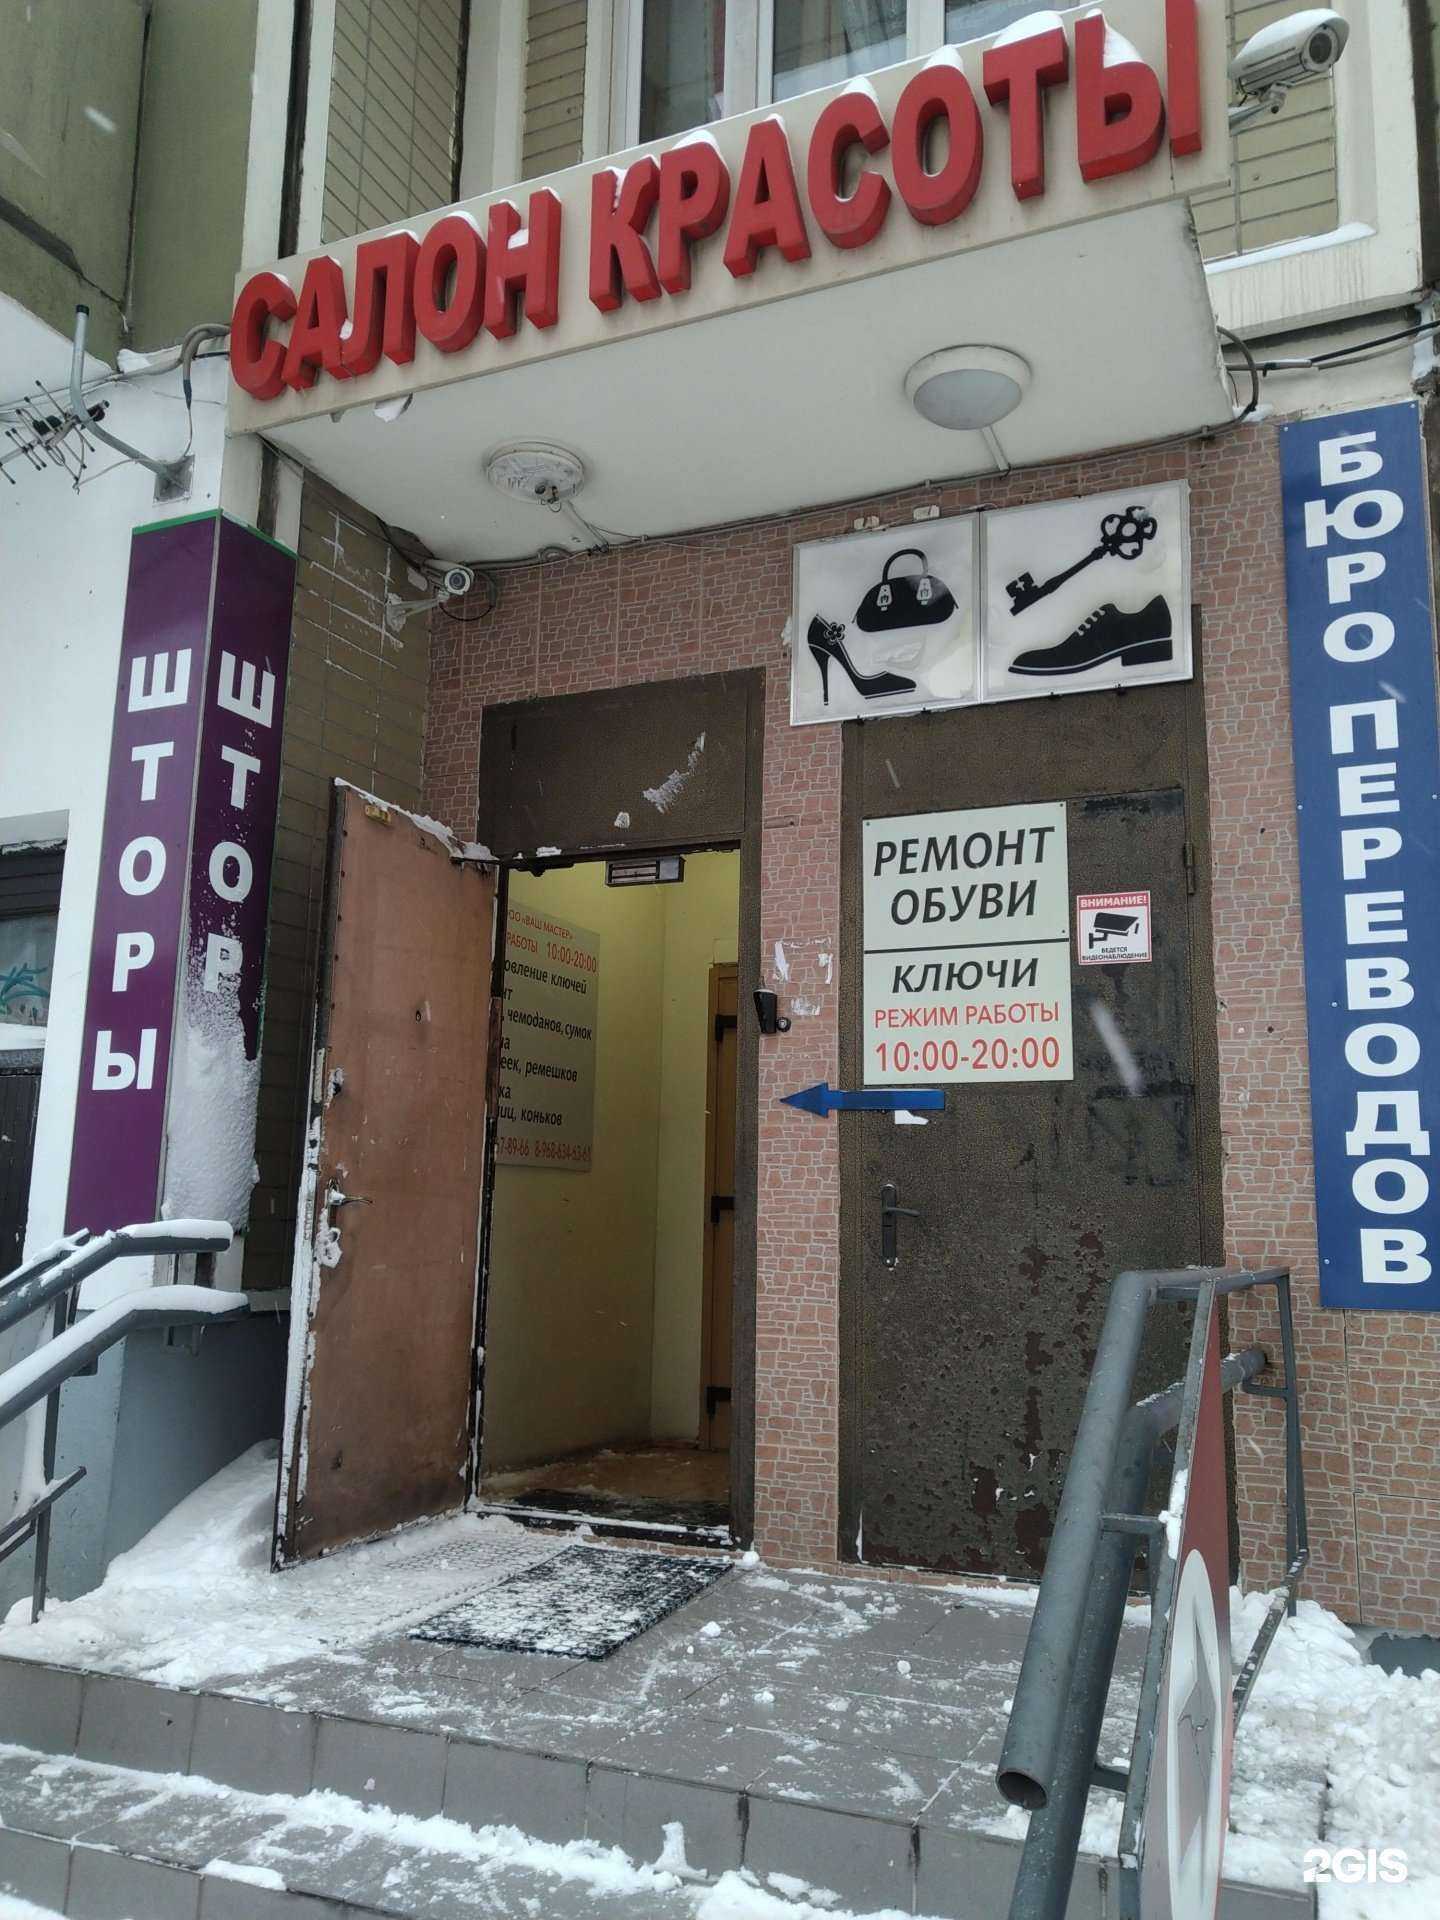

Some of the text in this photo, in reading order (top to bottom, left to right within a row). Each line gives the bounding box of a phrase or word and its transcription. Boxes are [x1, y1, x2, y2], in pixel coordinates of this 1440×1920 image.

[230, 0, 1201, 400] САЛОН КРАСОТЫ
[204, 650, 276, 993] ШТОР
[873, 826, 1056, 877] РЕМОНТ
[1304, 431, 1433, 1285] БЮРО ПЕРЕВОДОВ
[91, 648, 192, 1091] ШТОРЫ
[890, 879, 1038, 926] ОБУВИ
[1080, 895, 1148, 908] ВНИМАНИЕ!
[546, 940, 597, 974] 10:00-20:00
[1082, 951, 1147, 961] ВИДЕОНАБЛЮДЕНИЕ
[1101, 946, 1128, 954] ВЕДЕТСЯ
[550, 973, 587, 995] ключей
[892, 957, 1039, 994] КЛЮЧИ
[564, 1023, 592, 1041] сумок
[874, 1001, 1059, 1029] РЕЖИМ РАБОТЫ
[525, 1060, 578, 1083] ремешков
[876, 1036, 1060, 1073] 10:00-20:00
[521, 1107, 563, 1127] коньков
